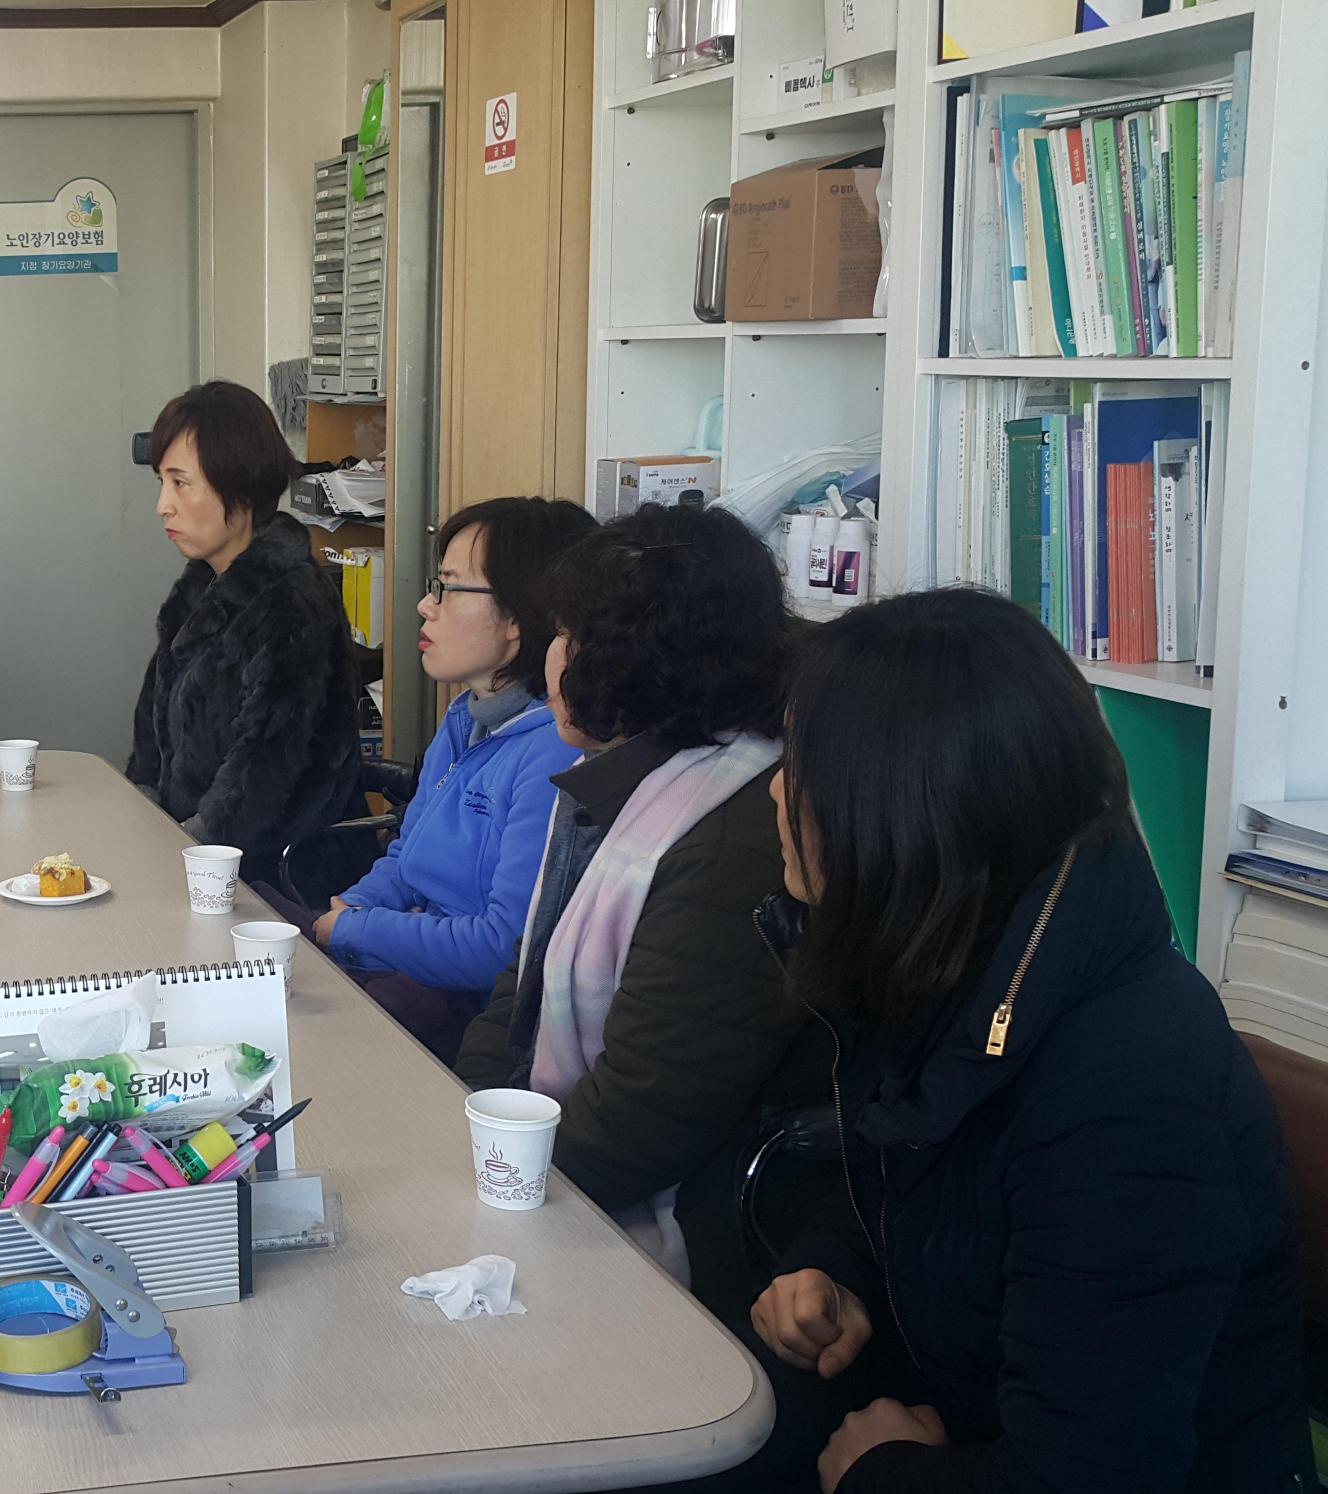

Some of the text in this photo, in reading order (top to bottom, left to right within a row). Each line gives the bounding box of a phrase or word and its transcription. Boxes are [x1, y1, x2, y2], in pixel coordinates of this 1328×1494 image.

[5, 230, 104, 248] 노인장기요양보험
[21, 259, 92, 271] 지정 장기요양기관
[125, 1067, 210, 1108] 후레시아
